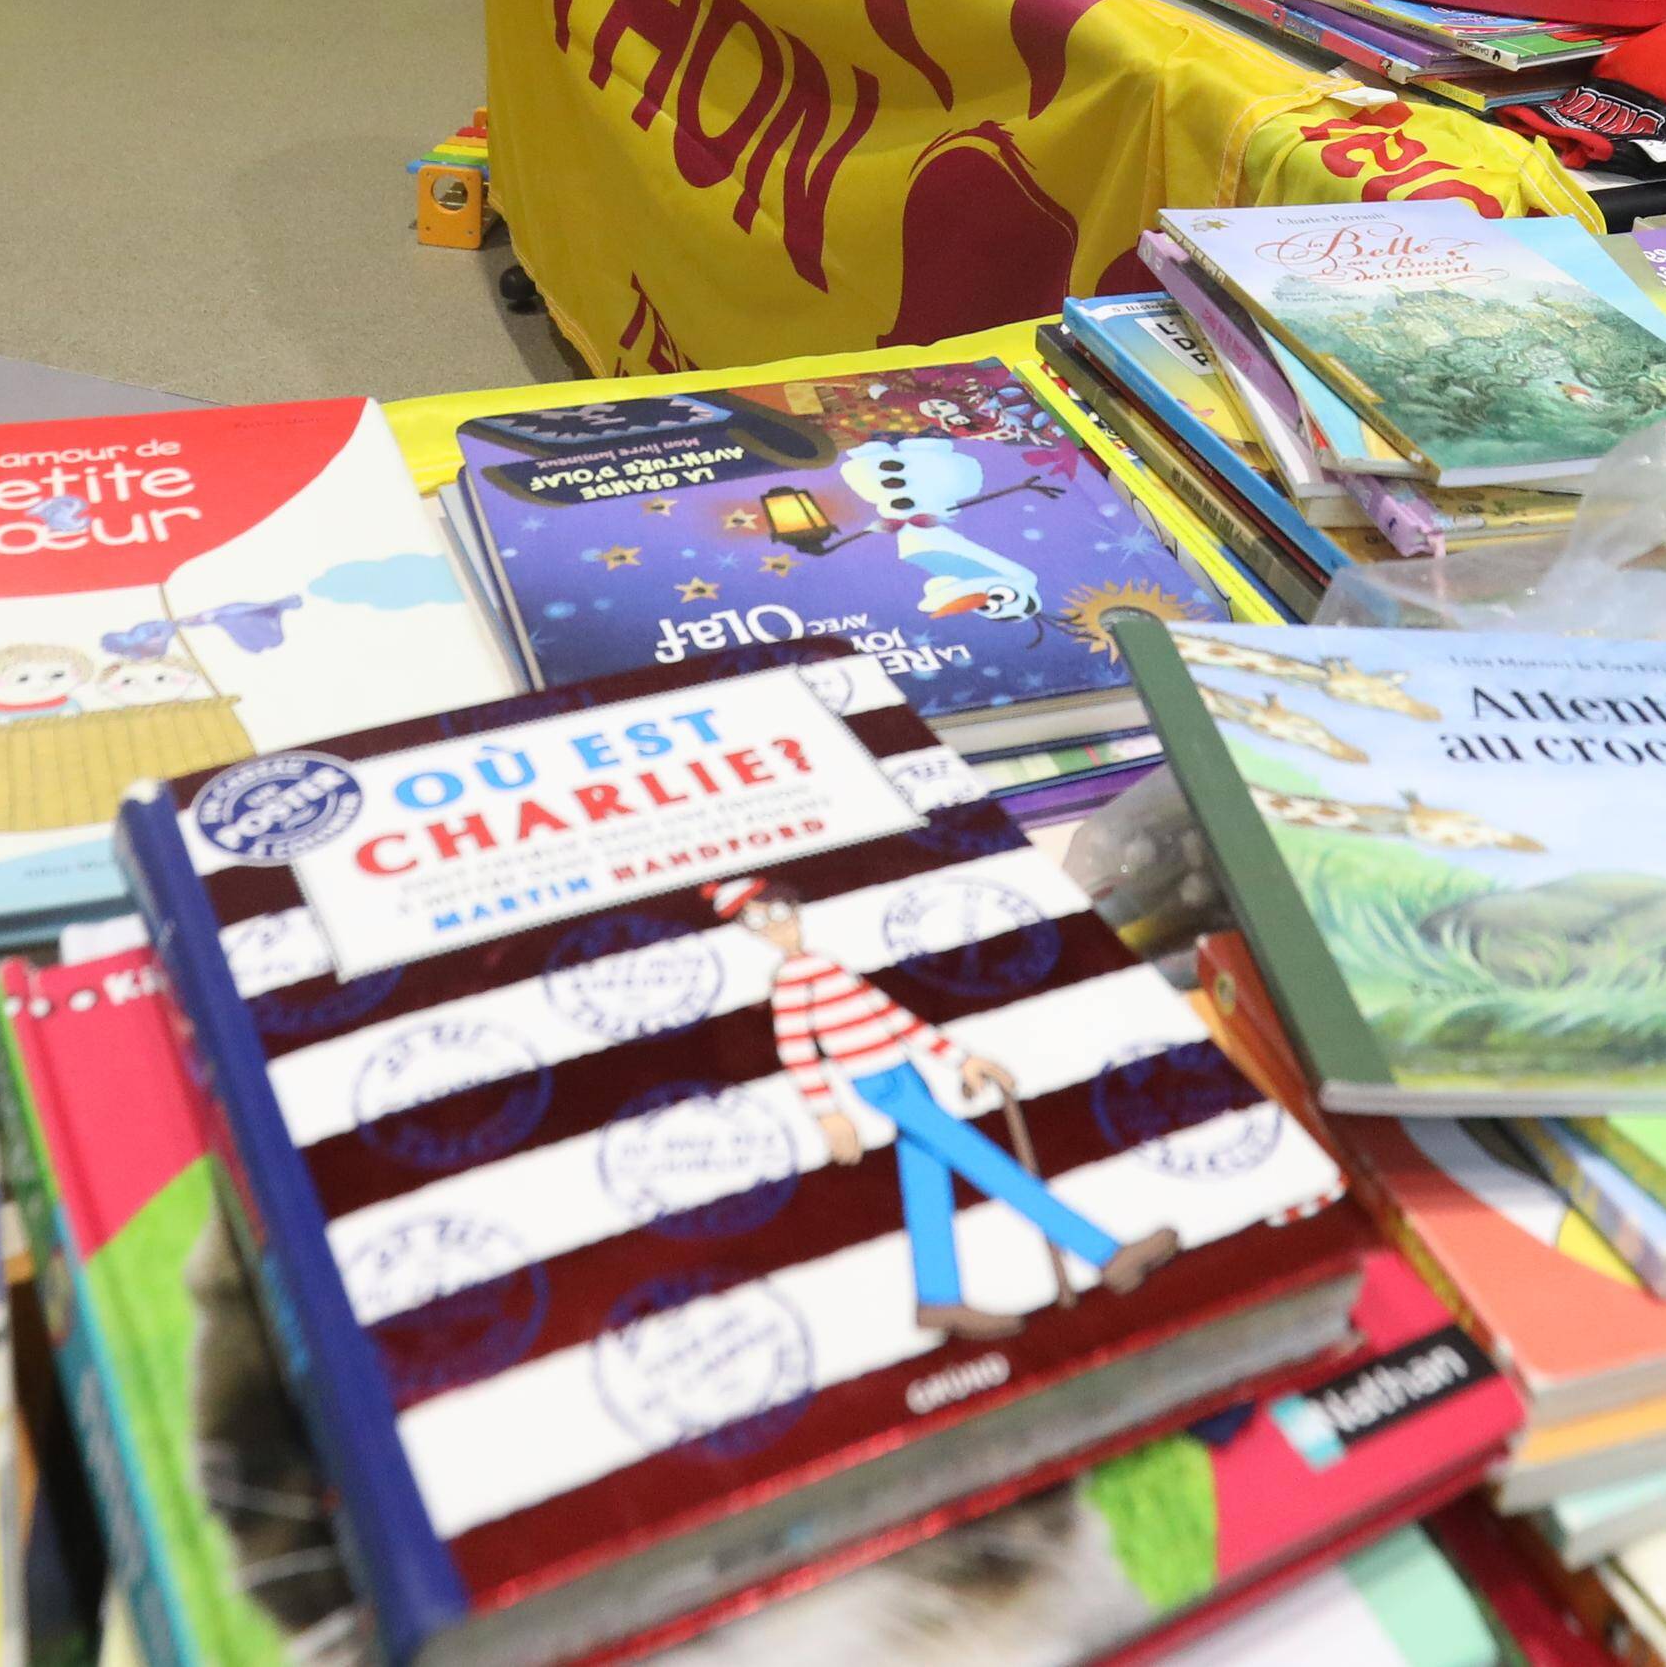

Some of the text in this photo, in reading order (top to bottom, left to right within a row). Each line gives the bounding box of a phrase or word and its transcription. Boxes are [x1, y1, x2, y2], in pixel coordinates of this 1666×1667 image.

[1276, 210, 1389, 230] Charles Perrault
[1320, 223, 1433, 264] Belle
[1383, 251, 1450, 273] Bois
[1343, 262, 1476, 285] dormant
[136, 437, 181, 458] de
[536, 437, 701, 470] Mon livre lumineux
[530, 447, 746, 492] AVENTURE D'OLAF
[581, 467, 717, 501] LA GRANDE
[654, 604, 869, 665] AVEC Olaf
[937, 644, 972, 665] LA
[393, 707, 724, 811] OÙ EST
[1441, 732, 1521, 765] au
[213, 764, 349, 847] POSTER
[352, 736, 814, 877] CHARLIE?
[612, 816, 828, 884] HANDFORD
[1318, 1339, 1467, 1435] Nathan
